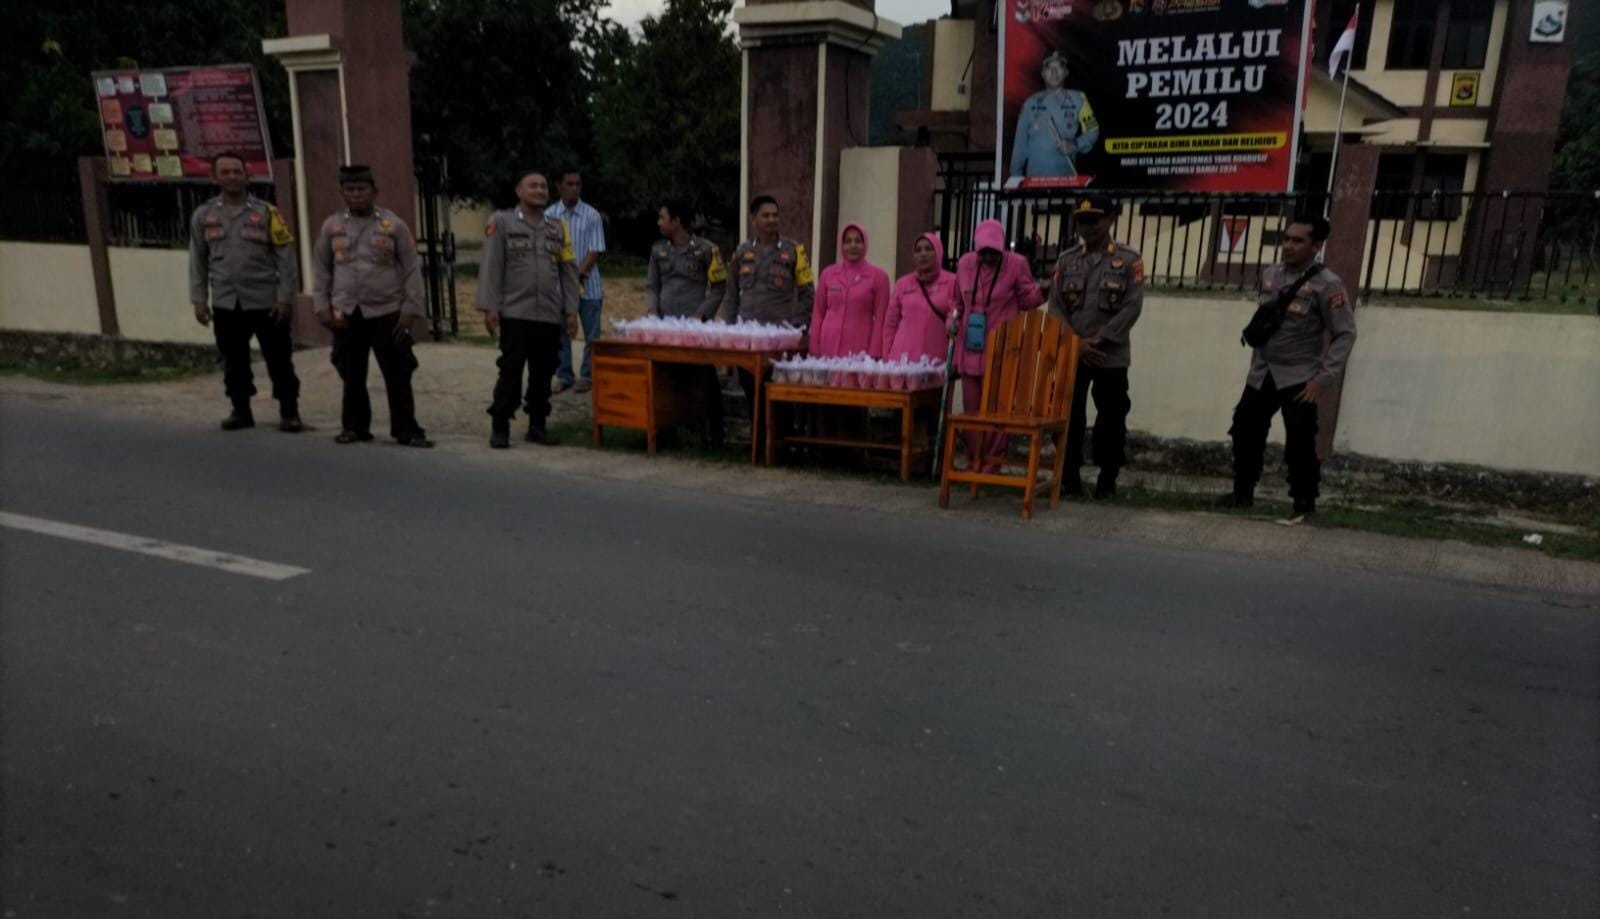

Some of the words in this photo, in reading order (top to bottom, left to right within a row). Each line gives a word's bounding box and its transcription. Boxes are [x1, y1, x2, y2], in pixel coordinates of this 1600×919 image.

[1117, 28, 1283, 67] MELALUI
[1125, 64, 1268, 100] PEMILU
[1155, 100, 1230, 131] 2024
[1130, 140, 1168, 150] CIPTAKAN
